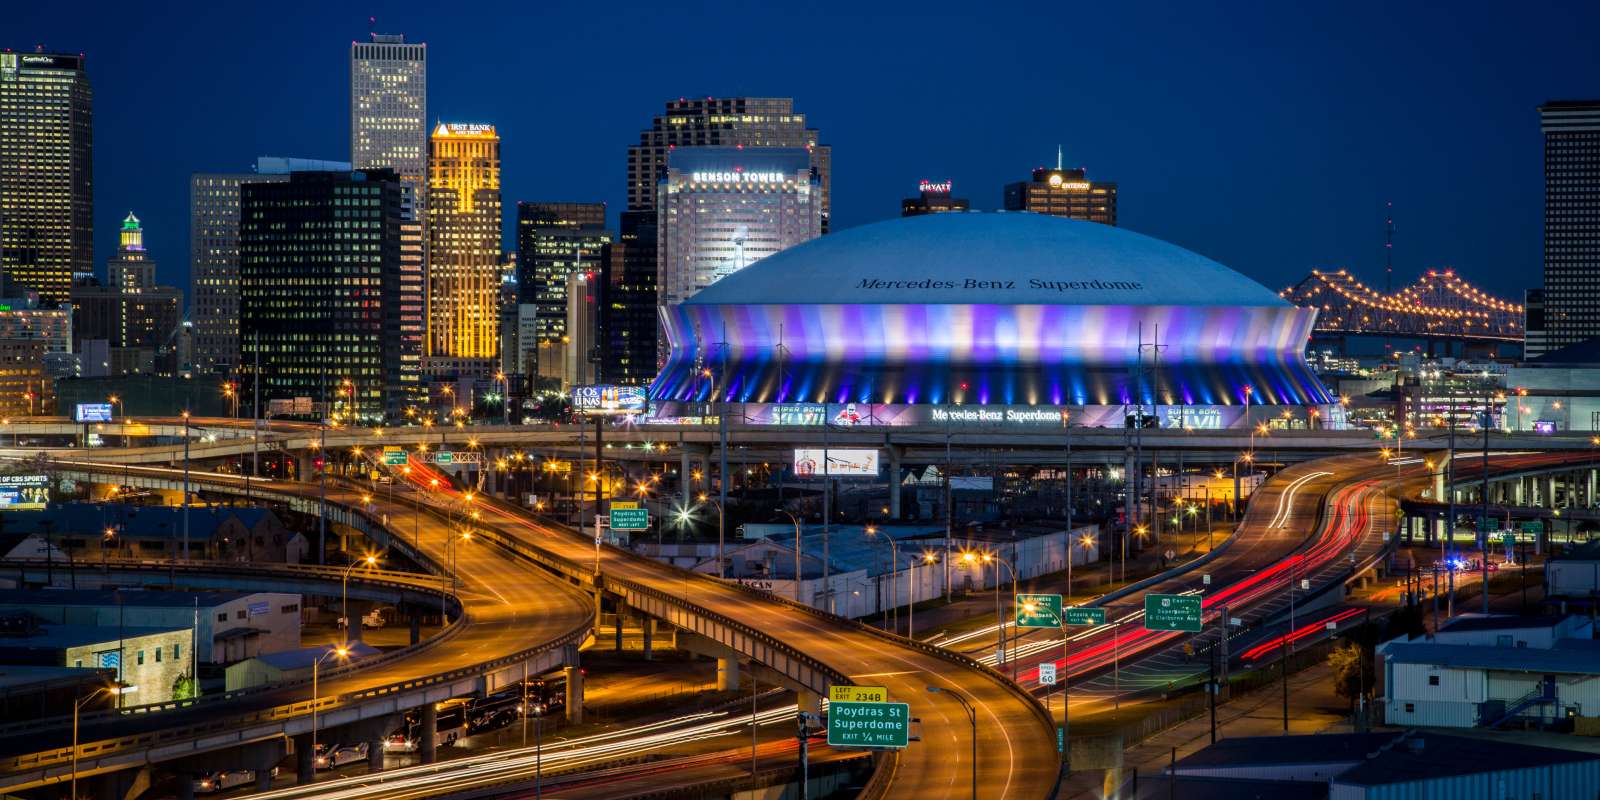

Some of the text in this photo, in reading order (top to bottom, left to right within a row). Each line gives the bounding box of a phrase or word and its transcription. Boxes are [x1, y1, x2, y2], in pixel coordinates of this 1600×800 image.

[693, 172, 785, 182] BENSON TOWER
[926, 183, 951, 192] HYATT
[855, 278, 1144, 292] Mercedes-Benz Superdome
[574, 397, 600, 406] LUNAS
[932, 409, 1062, 422] Mercedes-Benz Superdome
[1041, 675, 1054, 683] 60
[856, 693, 881, 702] 234B
[836, 706, 901, 718] Poydras St
[834, 719, 903, 730] Superdome
